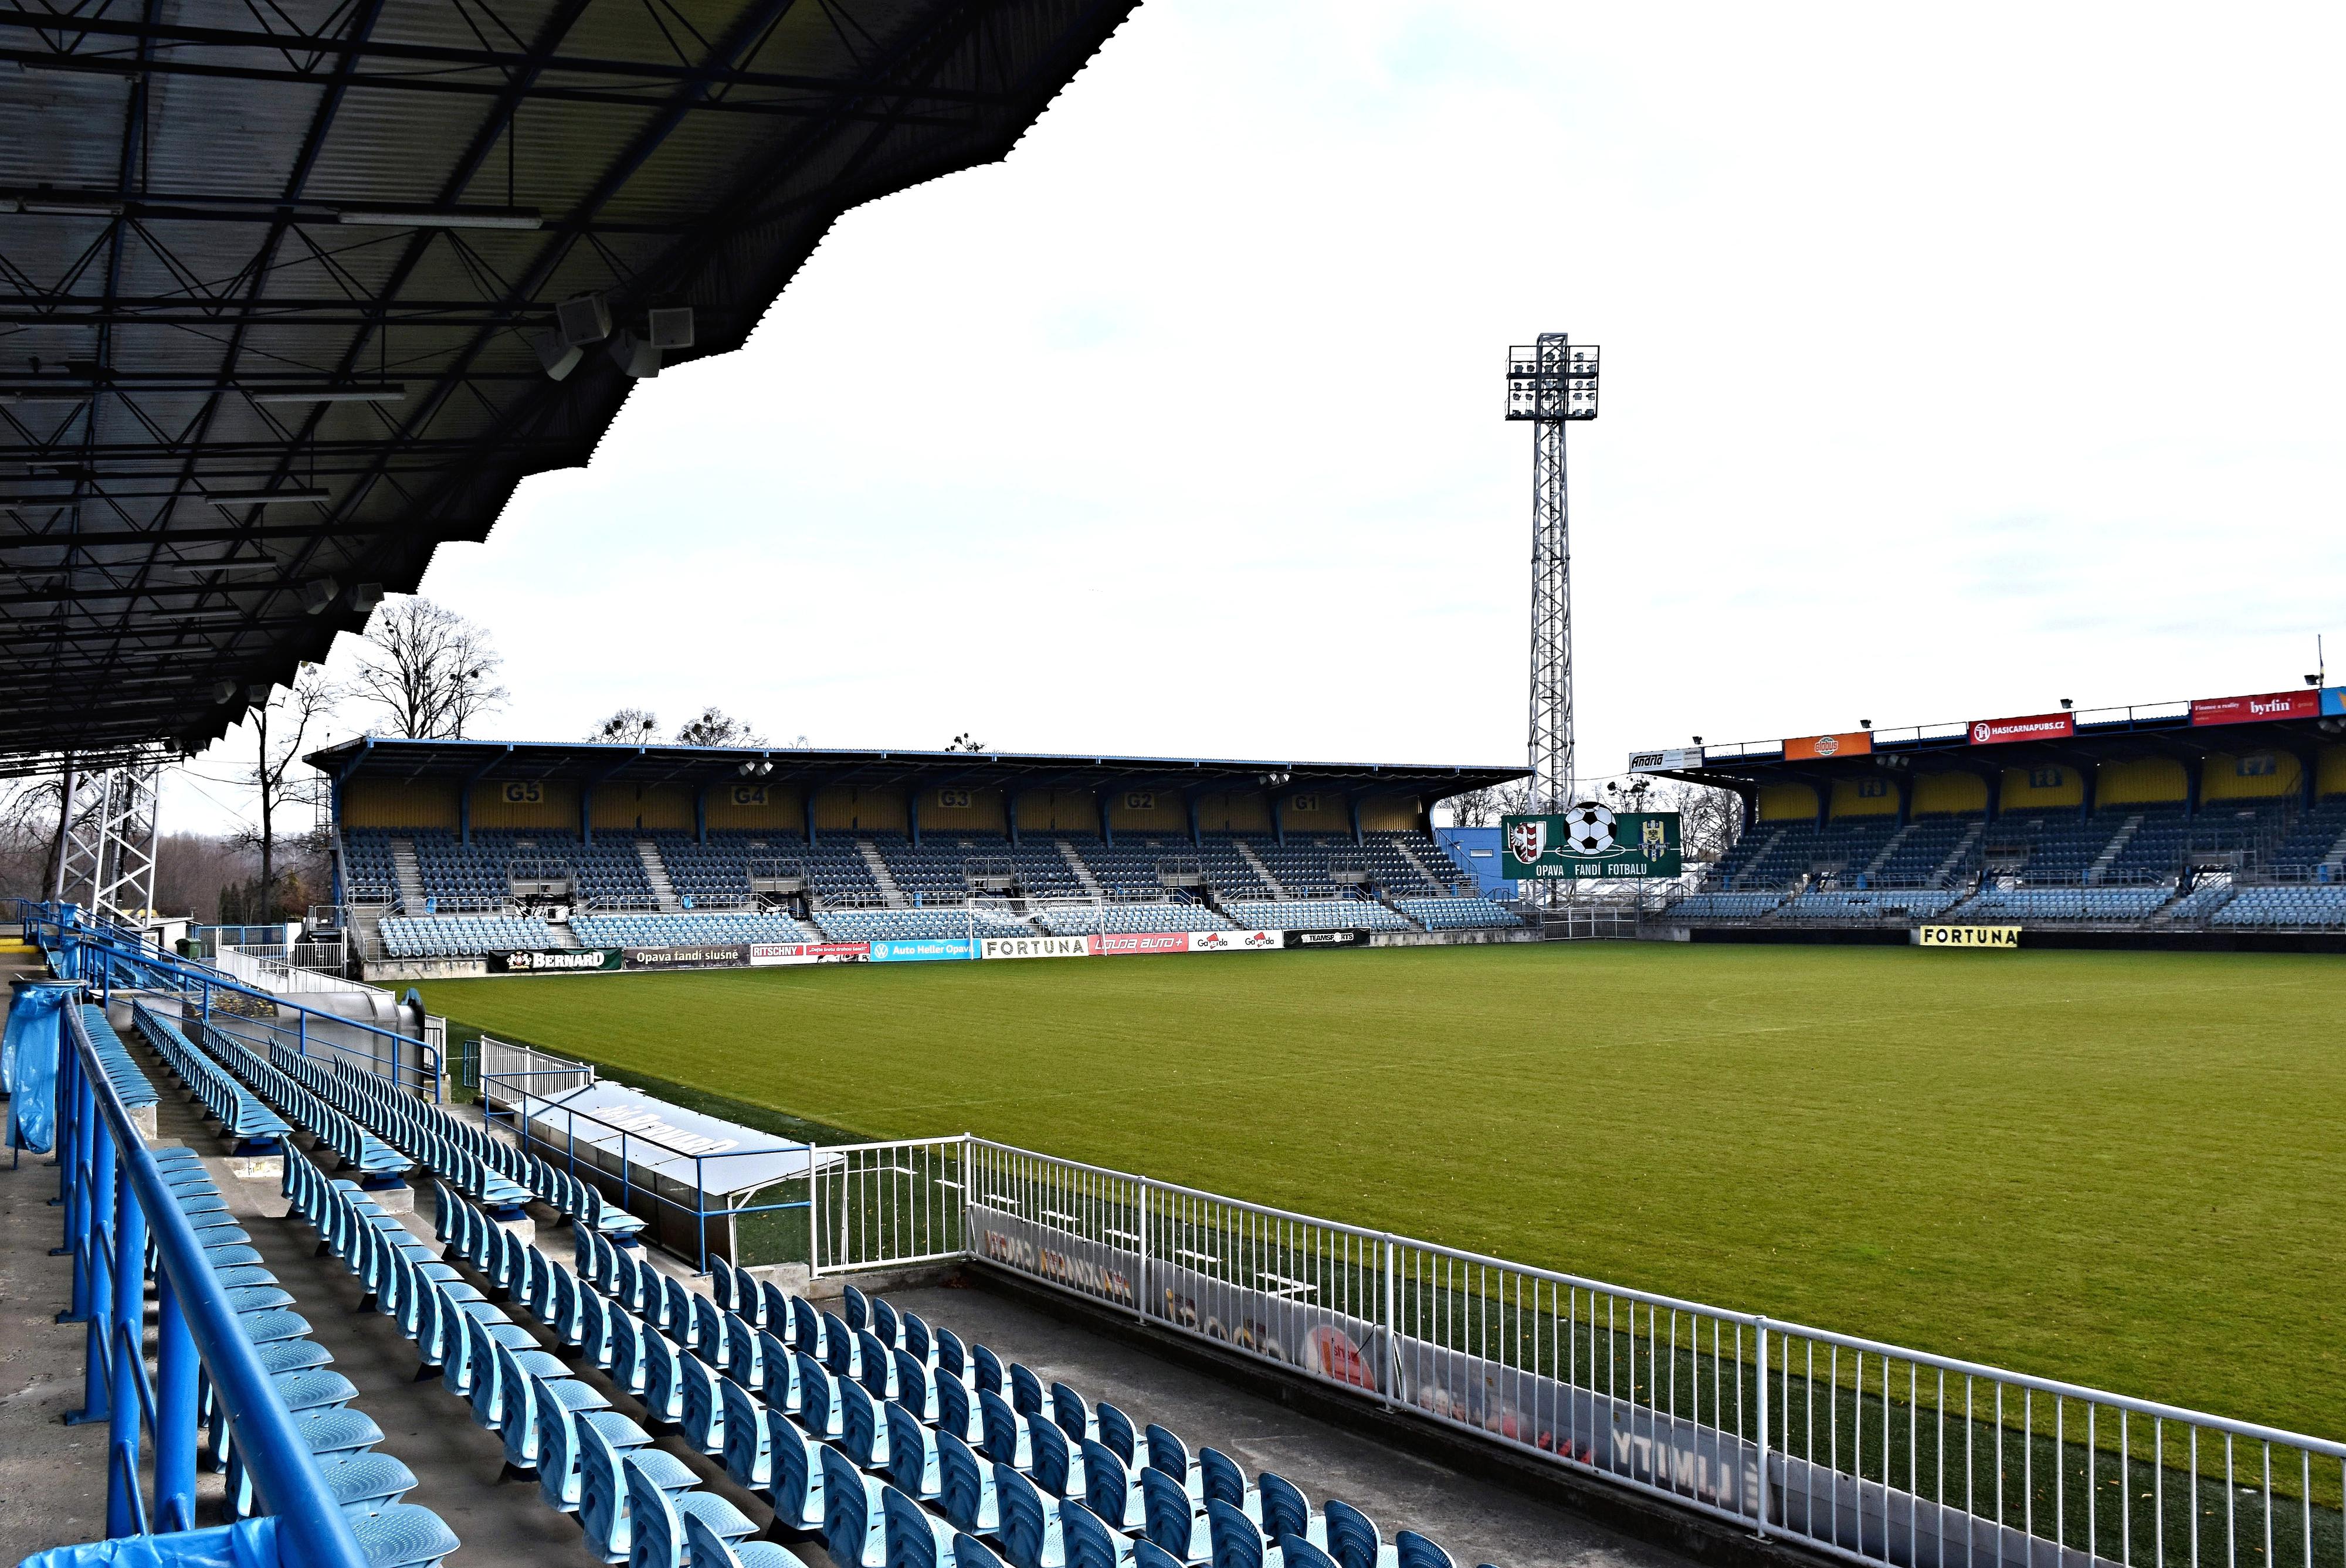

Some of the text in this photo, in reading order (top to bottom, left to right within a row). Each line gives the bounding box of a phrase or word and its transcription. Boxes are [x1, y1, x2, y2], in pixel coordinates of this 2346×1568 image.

[2250, 700, 2290, 715] byrfin
[1992, 721, 2064, 735] HASICARNAPUBS.CZ
[506, 783, 540, 802] G5
[734, 786, 765, 804] G4
[941, 790, 968, 806] G3
[1127, 792, 1152, 809] G2
[1295, 795, 1316, 810] G1
[1536, 861, 1647, 876] OPAVA FANDÍ FOTBALU
[1924, 929, 2017, 944] FORTUNA
[754, 946, 798, 956] RITSCHNY
[893, 945, 915, 955] Auto
[917, 945, 944, 954] Heller
[986, 940, 1084, 956] FORTUNA
[533, 952, 604, 968] BERNARD
[637, 949, 739, 963] Opava fandí slušně
